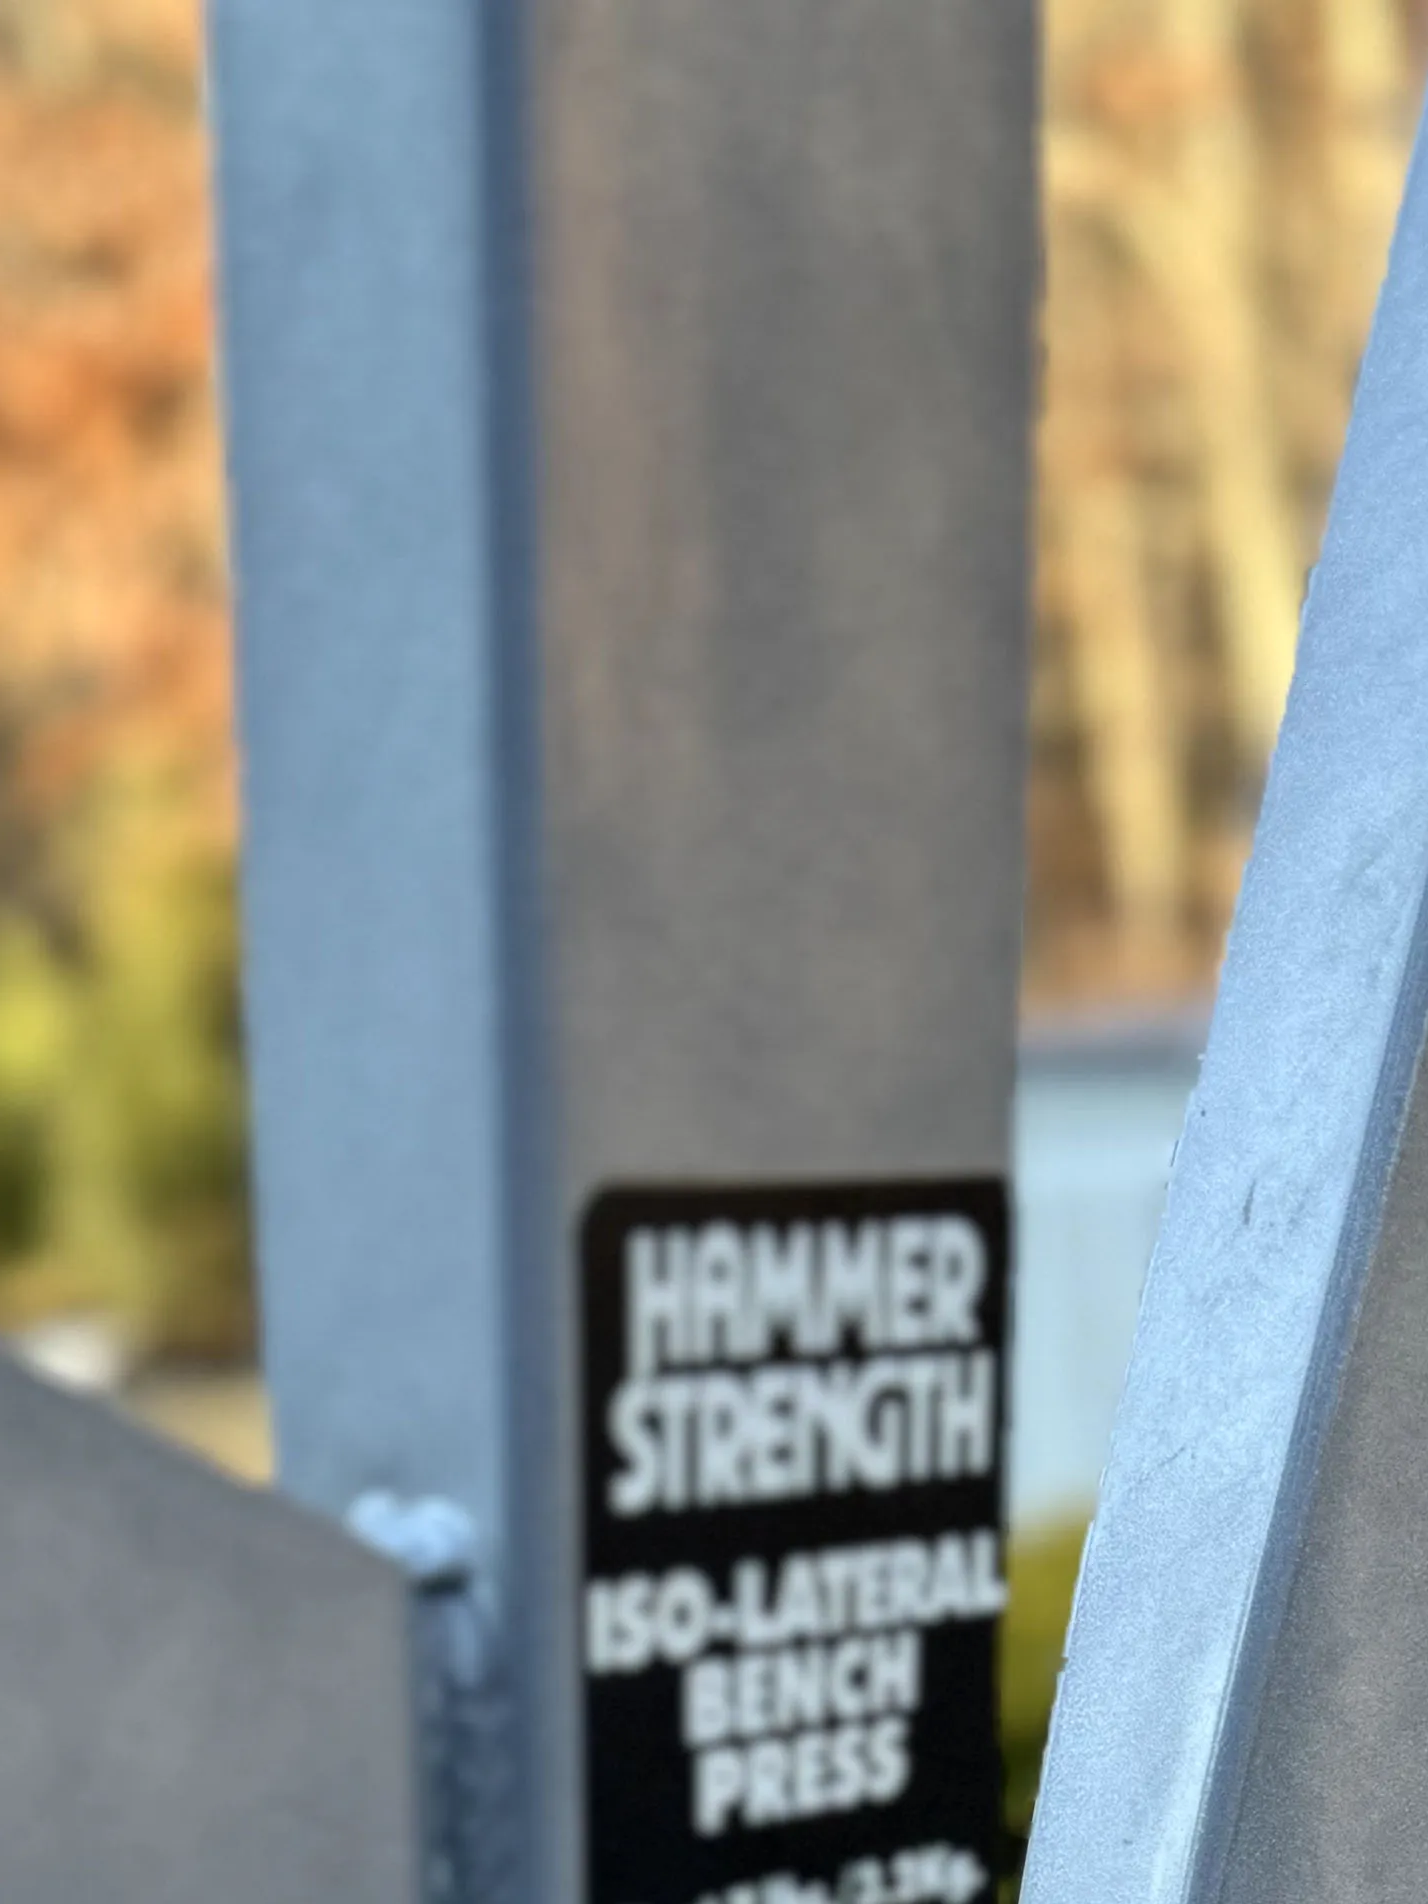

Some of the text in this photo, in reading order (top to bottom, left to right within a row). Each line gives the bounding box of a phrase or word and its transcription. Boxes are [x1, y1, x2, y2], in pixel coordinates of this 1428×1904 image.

[626, 1214, 989, 1382] HAMMER
[607, 1348, 995, 1518] STRENGTH
[585, 1528, 1008, 1674] ISO-LATERAL
[683, 1630, 921, 1749] BENCH
[693, 1717, 910, 1836] PRESS
